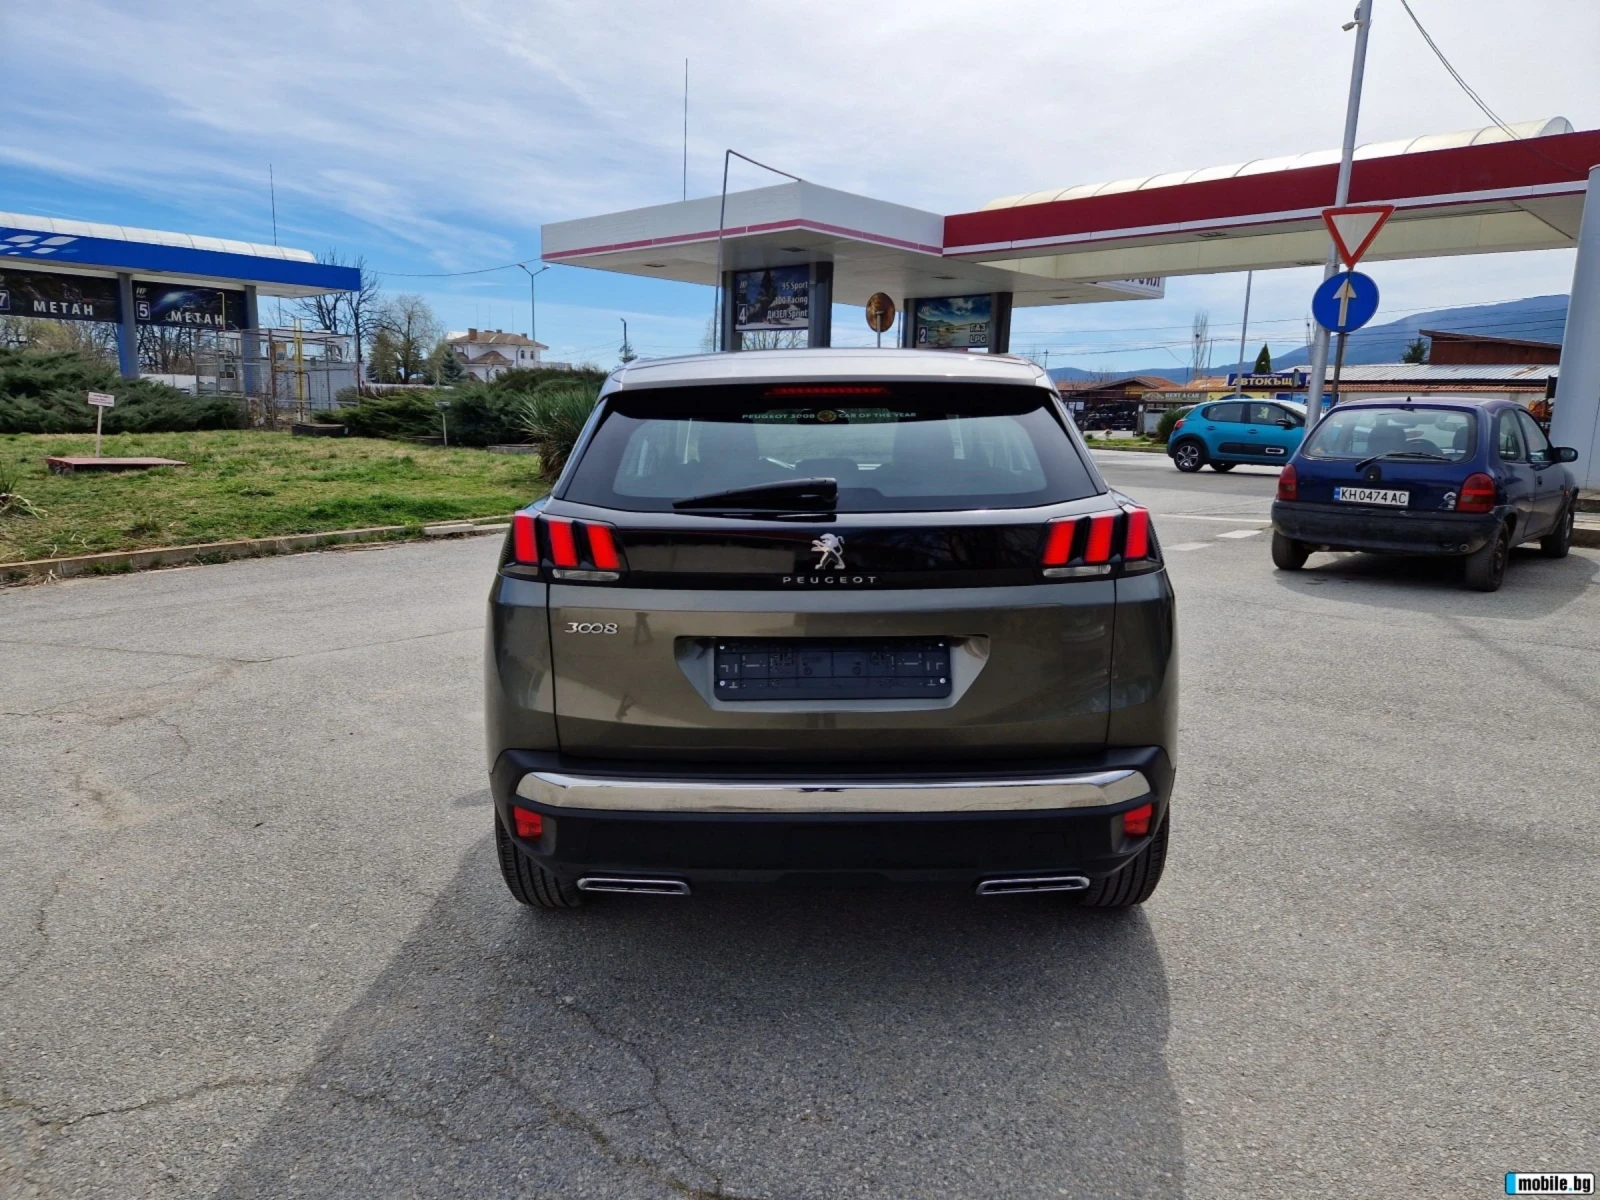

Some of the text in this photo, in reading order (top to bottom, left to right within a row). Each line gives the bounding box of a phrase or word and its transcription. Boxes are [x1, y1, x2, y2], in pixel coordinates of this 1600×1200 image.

[791, 281, 808, 291] Sport
[787, 295, 808, 305] Racing
[33, 300, 93, 316] МЕТАН
[139, 303, 148, 317] 5
[170, 310, 223, 325] МЕТАН
[738, 307, 746, 323] 4
[788, 309, 808, 320] Sprint
[970, 323, 986, 332] ГАЗ
[919, 328, 926, 342] 2
[970, 334, 986, 343] LPG
[1231, 377, 1301, 386] АВТОКЪЩ
[782, 576, 877, 584] PEUGEOT
[564, 622, 618, 634] 3008
